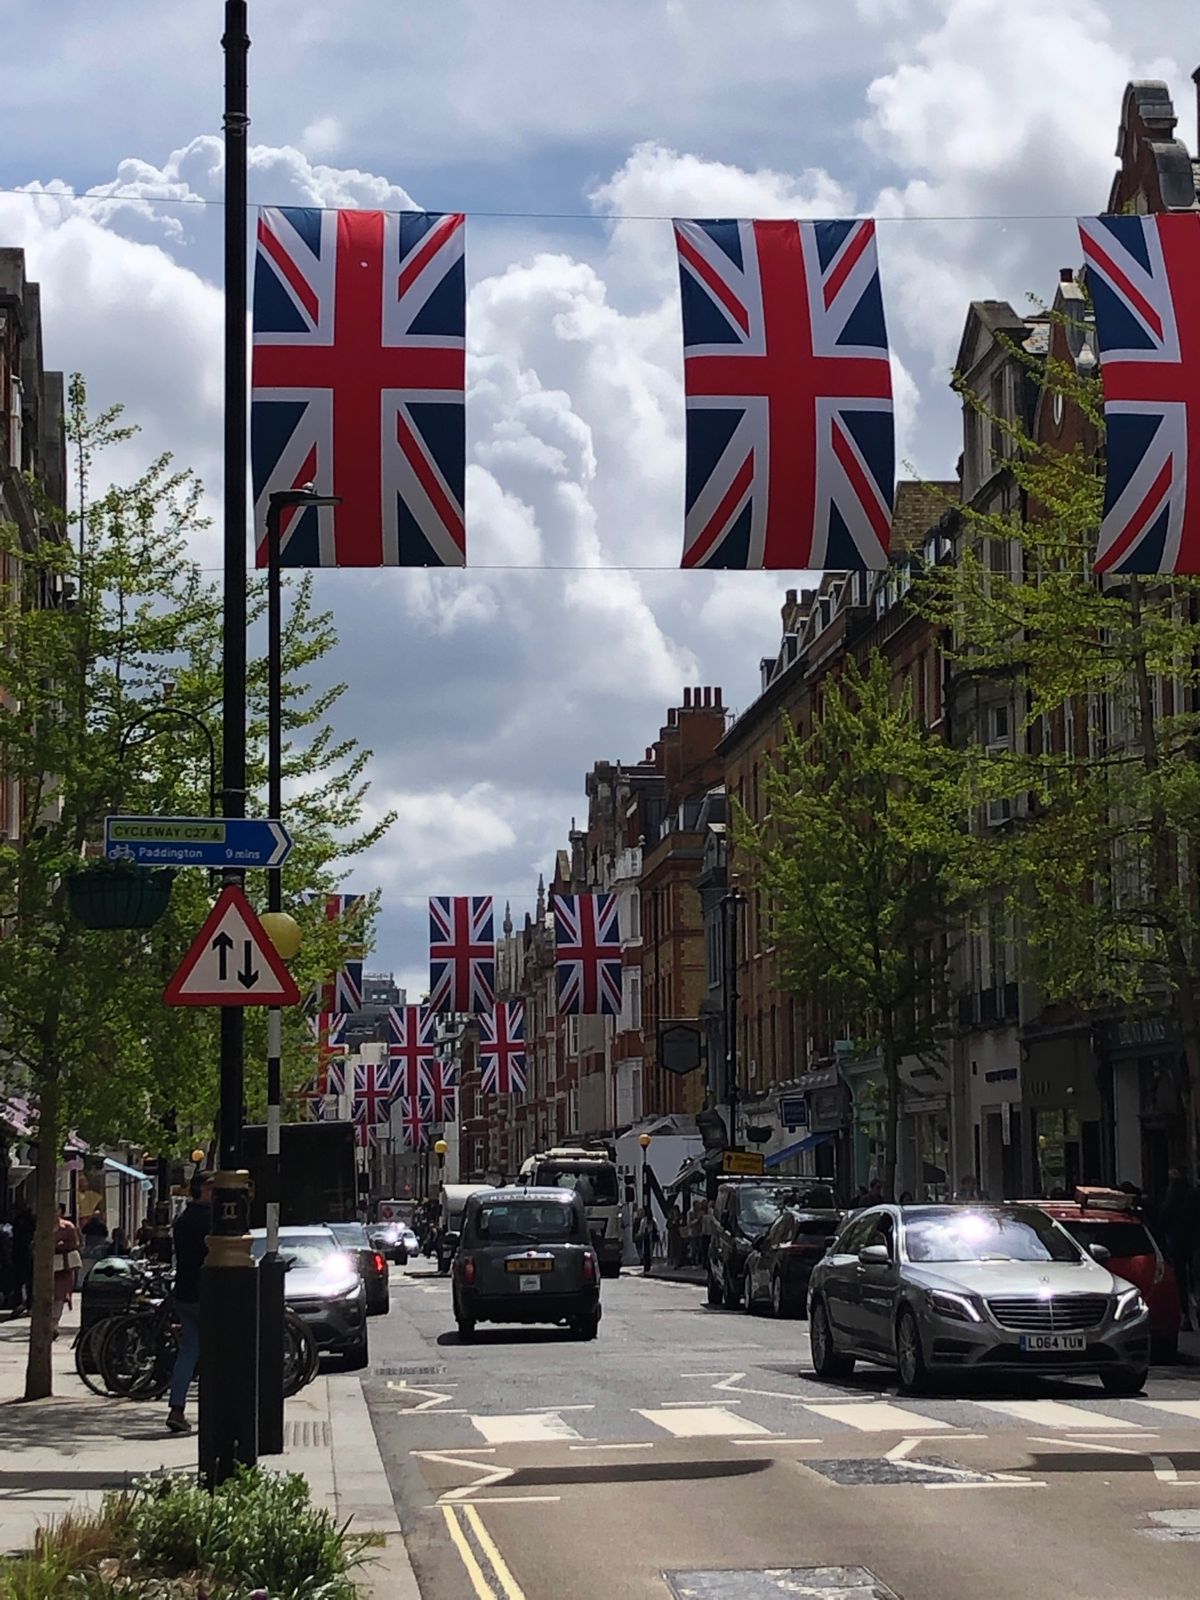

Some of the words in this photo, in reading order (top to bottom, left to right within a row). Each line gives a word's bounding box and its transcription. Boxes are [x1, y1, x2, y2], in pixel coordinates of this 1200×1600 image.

[114, 825, 181, 838] CYCLEWAY
[185, 827, 208, 838] C27
[138, 846, 203, 860] Paddington
[225, 848, 233, 859] 9
[235, 848, 261, 859] mins
